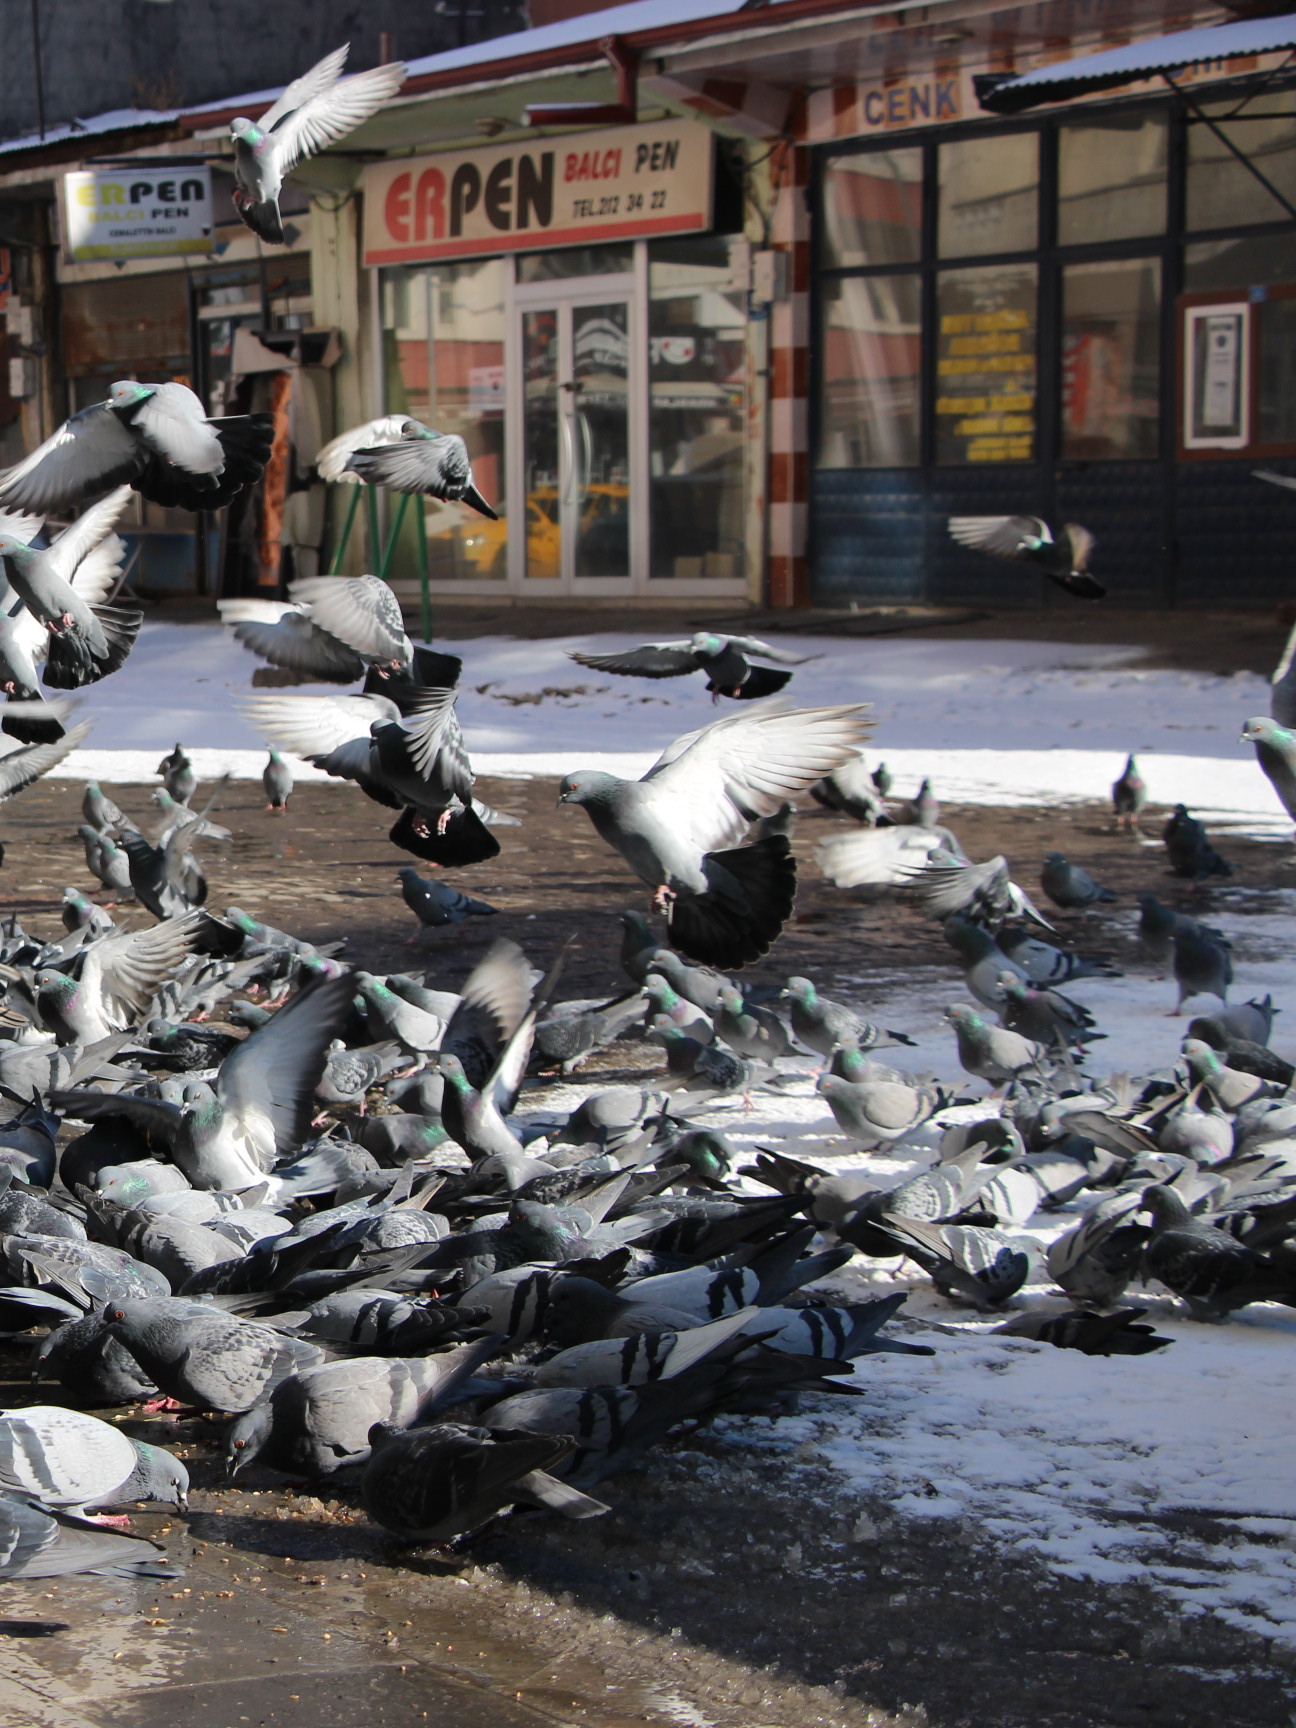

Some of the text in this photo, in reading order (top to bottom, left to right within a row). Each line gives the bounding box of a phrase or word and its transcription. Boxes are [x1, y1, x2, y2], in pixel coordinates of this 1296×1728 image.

[864, 80, 960, 127] CENK
[76, 178, 204, 206] ERPEN
[384, 140, 681, 243] ERPEN BALCI PEN
[626, 193, 644, 212] 34
[650, 190, 667, 209] 22
[152, 207, 189, 219] PEN
